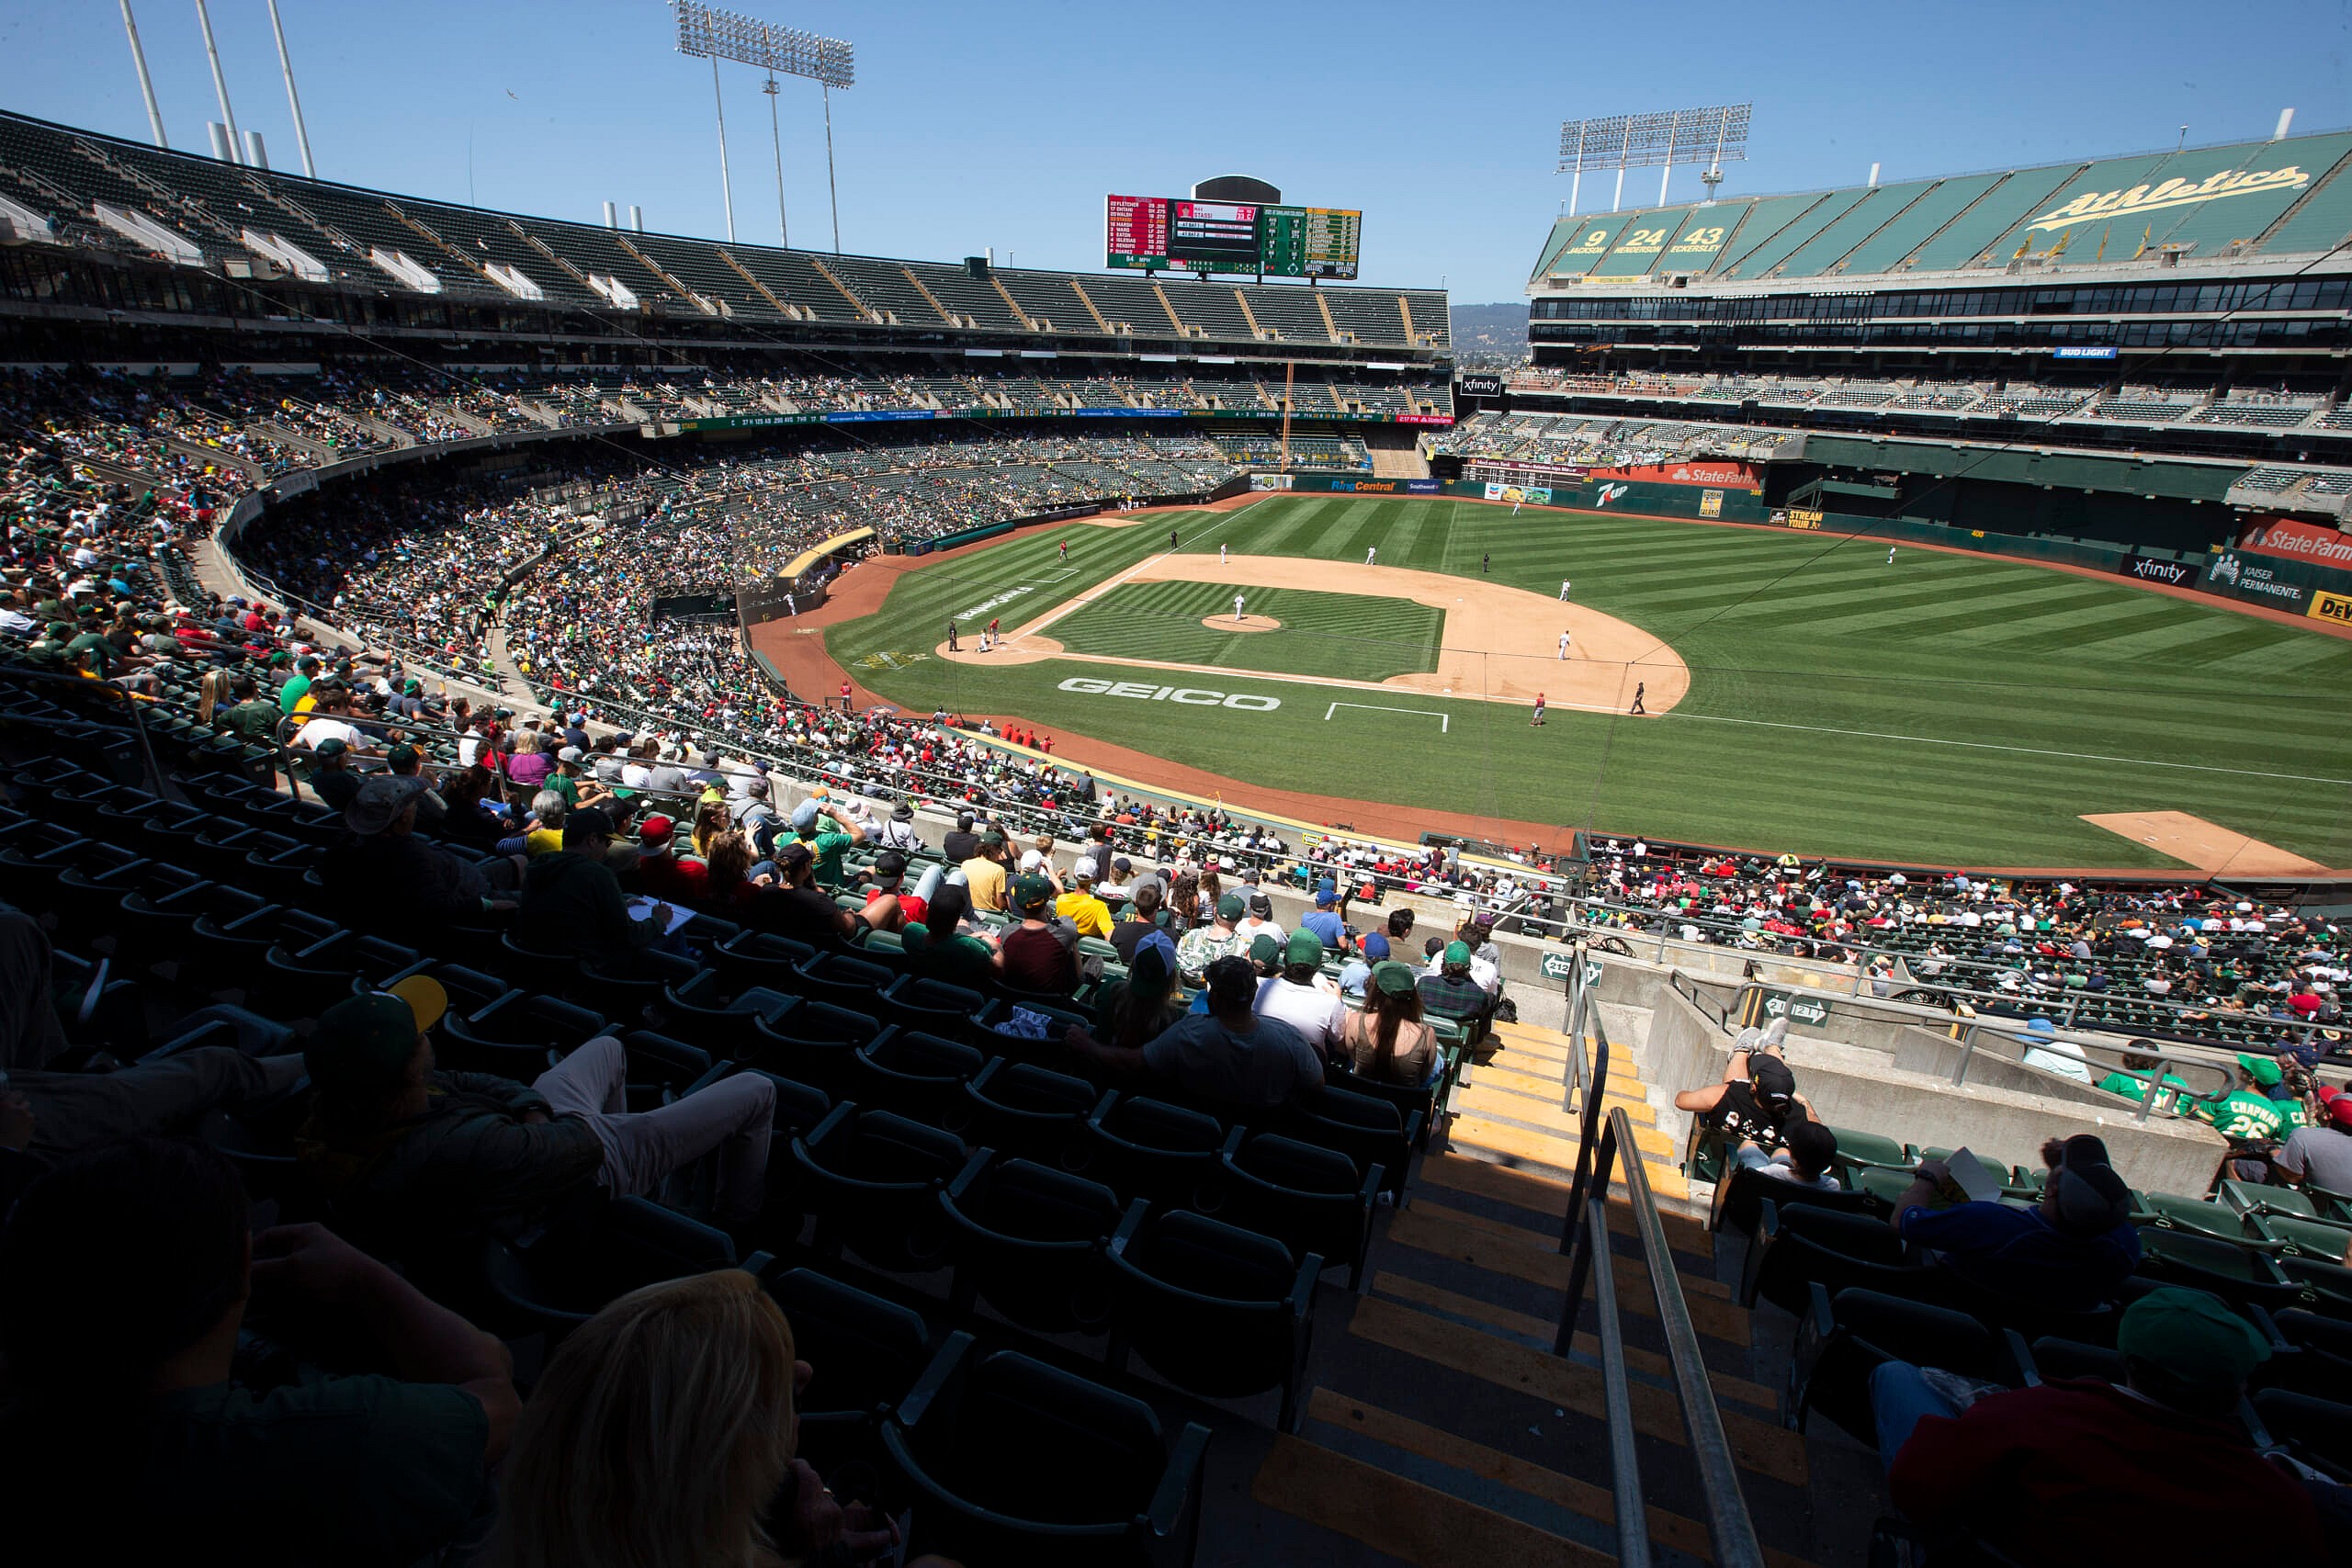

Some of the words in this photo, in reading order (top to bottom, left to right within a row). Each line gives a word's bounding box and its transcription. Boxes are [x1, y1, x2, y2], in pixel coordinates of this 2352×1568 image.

[2029, 165, 2310, 226] Athletics
[1584, 230, 1608, 247] 9
[1625, 229, 1667, 246] 24
[1683, 227, 1724, 245] 43
[1566, 246, 1606, 254] JACKSON
[1614, 245, 1663, 254] HENDERSON
[1670, 243, 1722, 253] ECKERSLEY
[2081, 348, 2111, 356] LIGHT
[1464, 378, 1498, 392] xfinity
[1250, 477, 1262, 486] Call
[1331, 479, 1396, 491] RingCentral
[1789, 510, 1824, 522] STREAM
[1788, 518, 1808, 530] YOUR
[2133, 558, 2188, 584] xfinity
[2244, 565, 2274, 581] KAISER
[2239, 578, 2299, 600] PERMANENTE
[1057, 677, 1282, 712] GEICO
[1549, 962, 1569, 972] 212
[2230, 1100, 2280, 1129] CHAPMAN
[2225, 1115, 2270, 1139] 26
